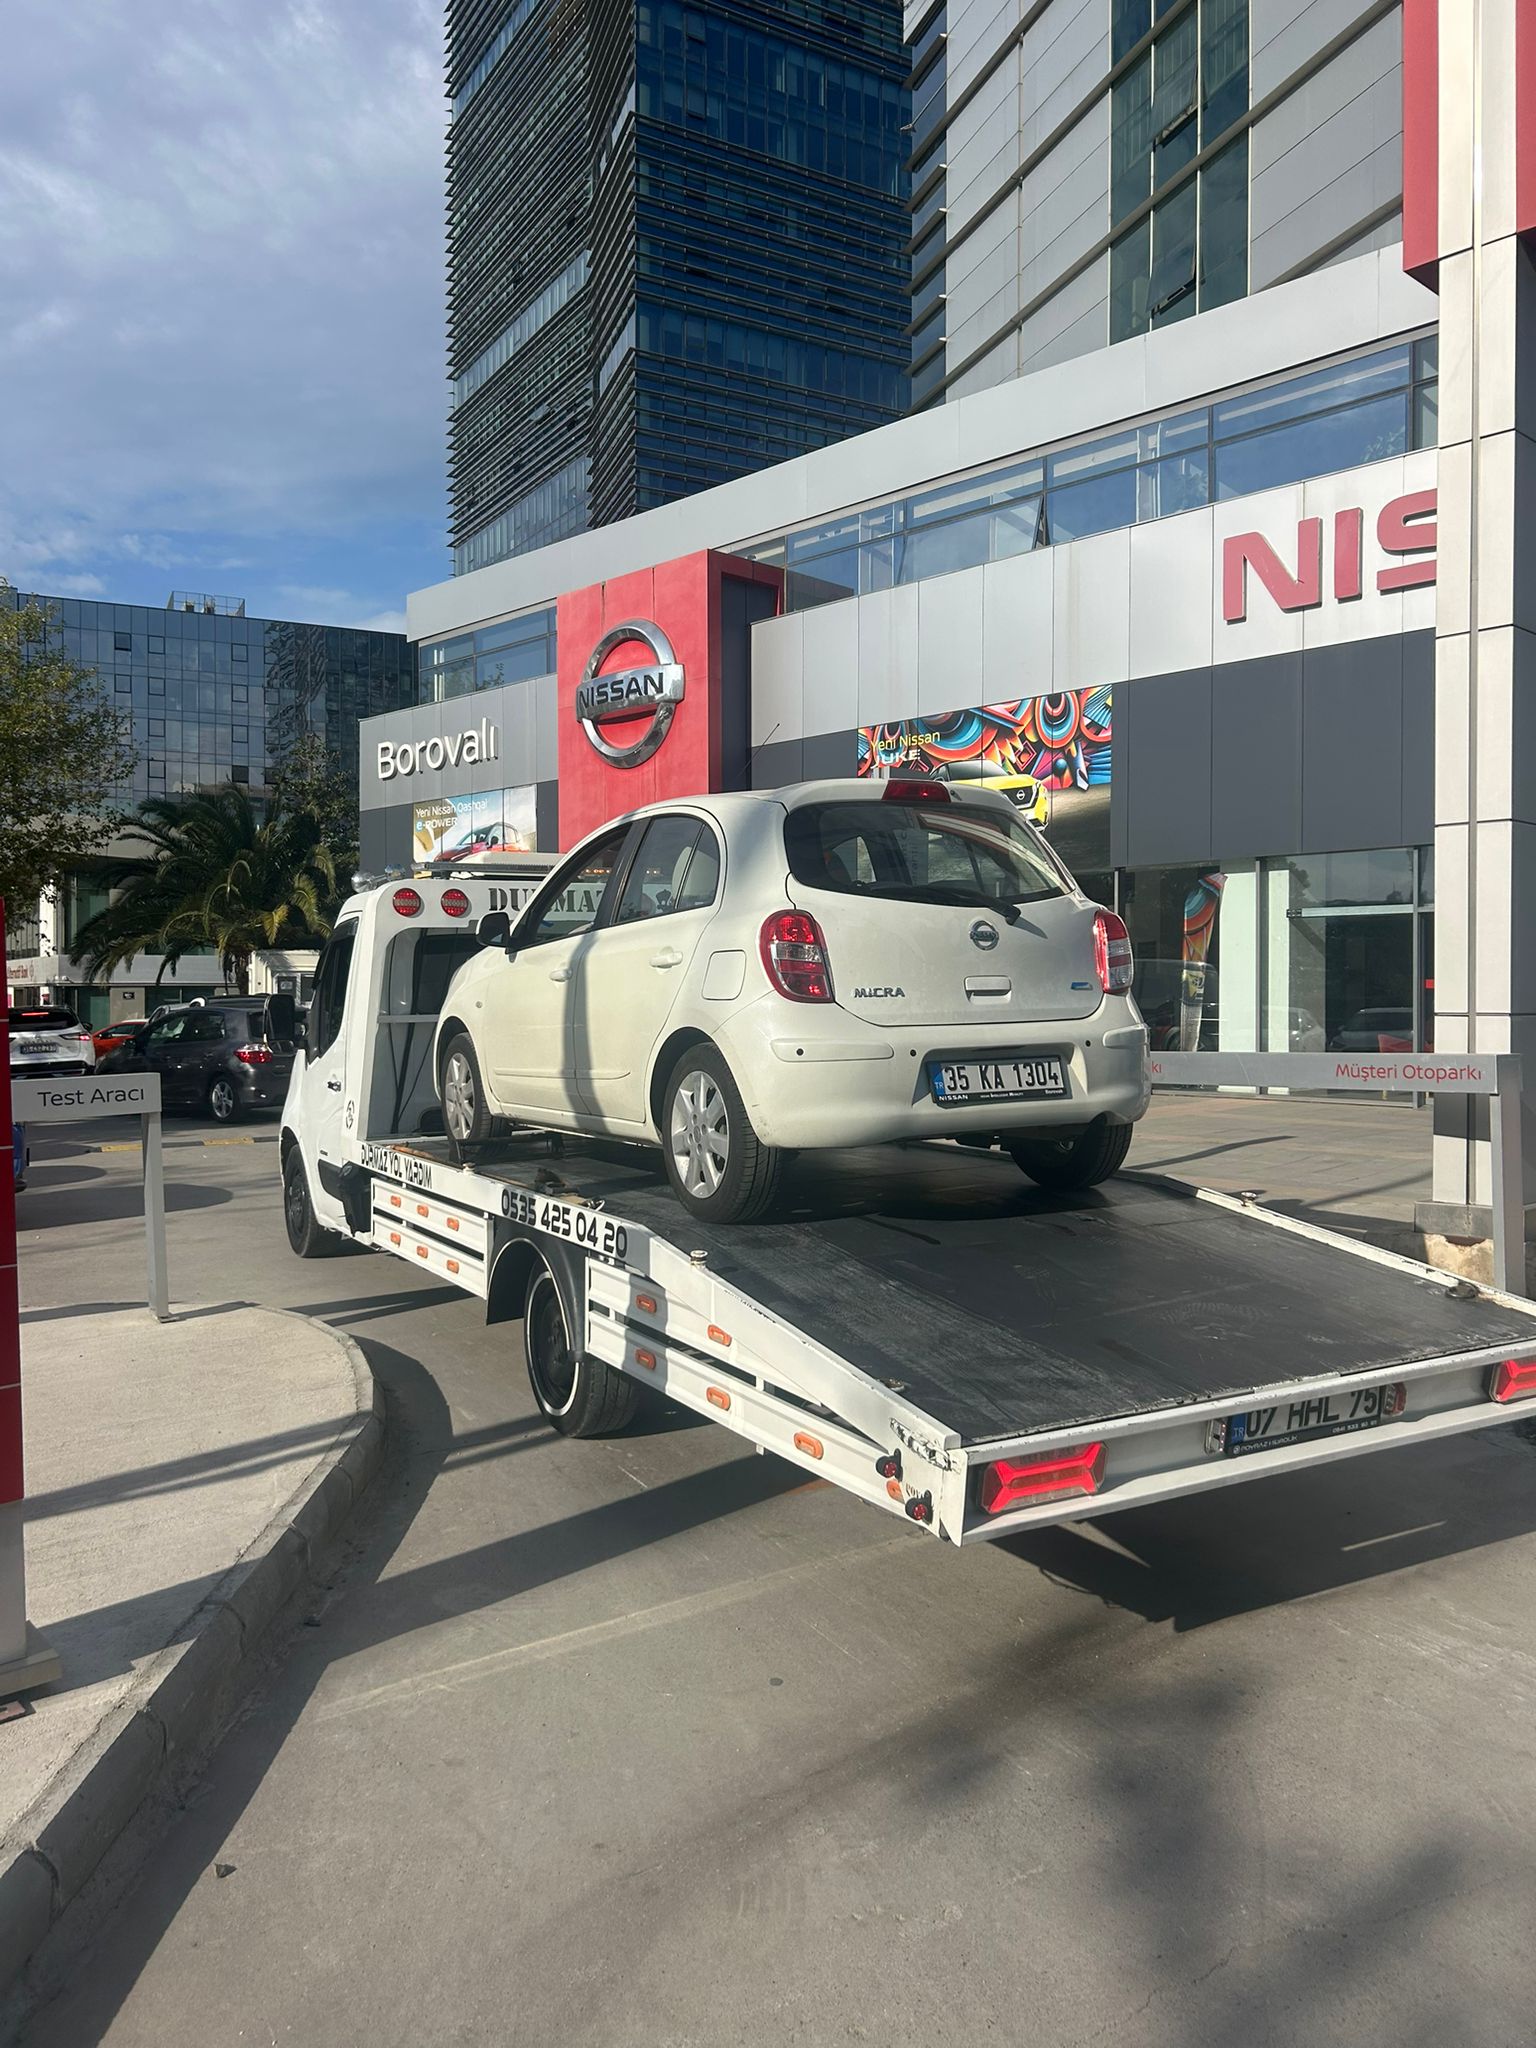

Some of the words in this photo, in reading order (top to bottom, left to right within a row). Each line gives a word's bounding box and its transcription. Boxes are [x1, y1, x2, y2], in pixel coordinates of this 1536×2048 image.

[578, 671, 665, 708] NISSAN
[377, 717, 499, 779] Borovalı
[870, 738, 896, 752] Yeni
[899, 732, 940, 748] Nissan
[872, 748, 921, 768] JUKE
[416, 806, 431, 818] Yeni
[432, 804, 455, 815] Nissan
[416, 817, 458, 831] e-POWER
[854, 987, 906, 998] MICRA
[934, 1081, 944, 1089] TR
[945, 1066, 969, 1091] 35
[979, 1064, 1004, 1089] KA
[1013, 1061, 1059, 1087] 1304
[1335, 1063, 1397, 1082] Müşteri
[1402, 1064, 1482, 1085] Otoparkı
[37, 1090, 85, 1107] Test
[90, 1087, 145, 1103] Aracı
[361, 1144, 388, 1173] DURMAZ
[389, 1151, 403, 1178] YOL
[404, 1157, 433, 1190] YARDIM
[502, 1188, 537, 1226] 0535
[541, 1202, 572, 1236] 425
[576, 1216, 598, 1248] 04
[603, 1225, 628, 1259] 20
[1234, 1426, 1244, 1437] TR
[1246, 1406, 1278, 1437] 07
[1287, 1396, 1340, 1431] HHL
[1350, 1387, 1378, 1418] 75
